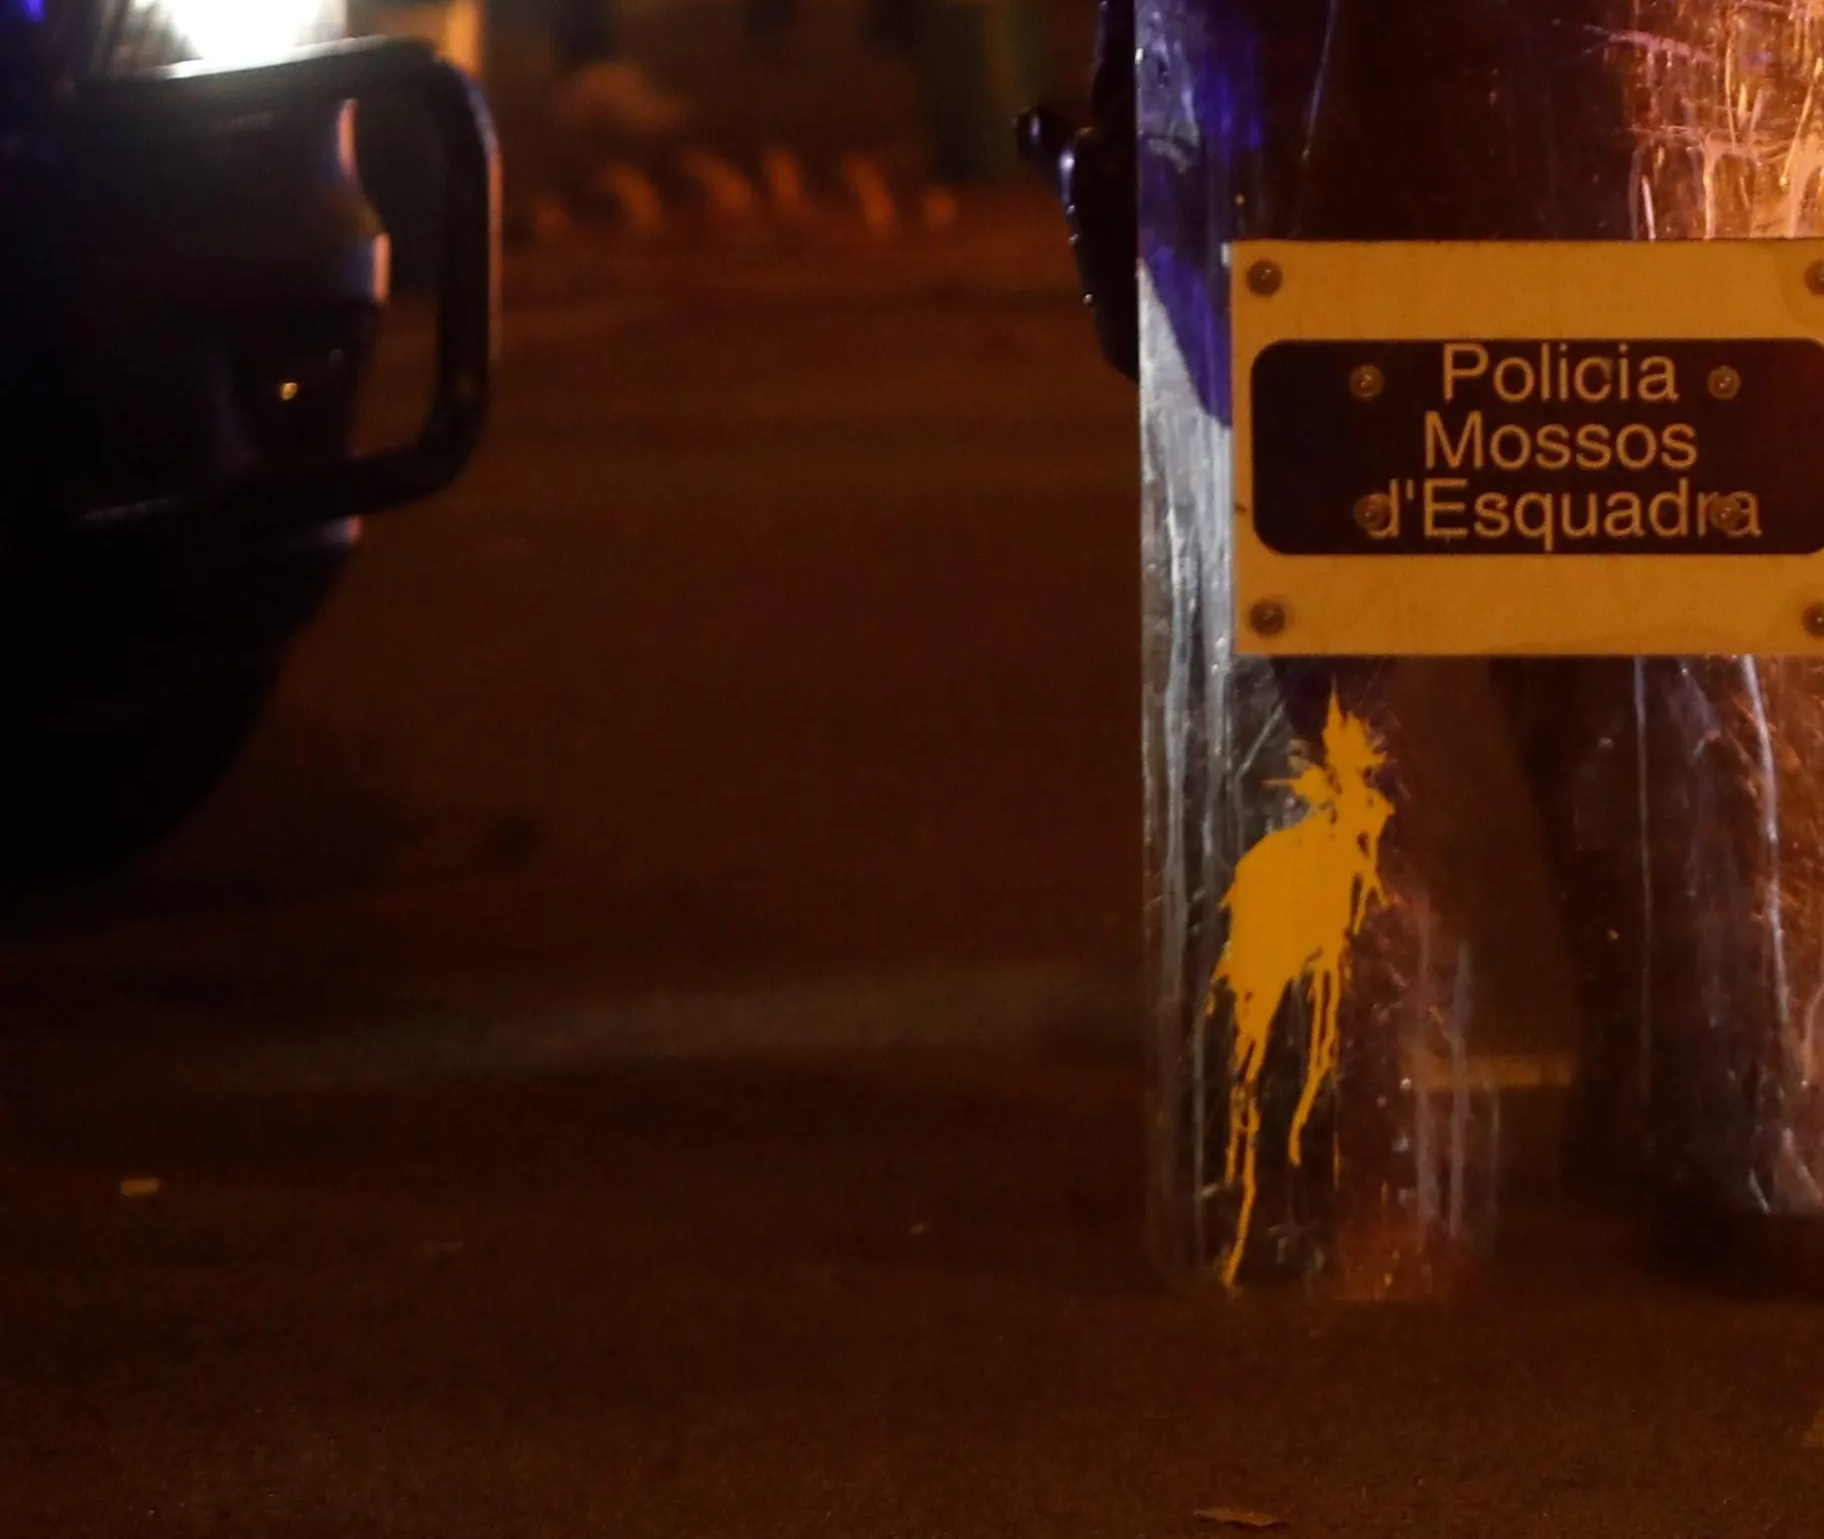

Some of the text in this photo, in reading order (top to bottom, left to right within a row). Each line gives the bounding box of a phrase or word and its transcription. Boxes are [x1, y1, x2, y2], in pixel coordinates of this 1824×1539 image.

[1442, 342, 1680, 402] Policia
[1424, 410, 1698, 470] Mossos
[1357, 478, 1762, 552] d'Esquadra
